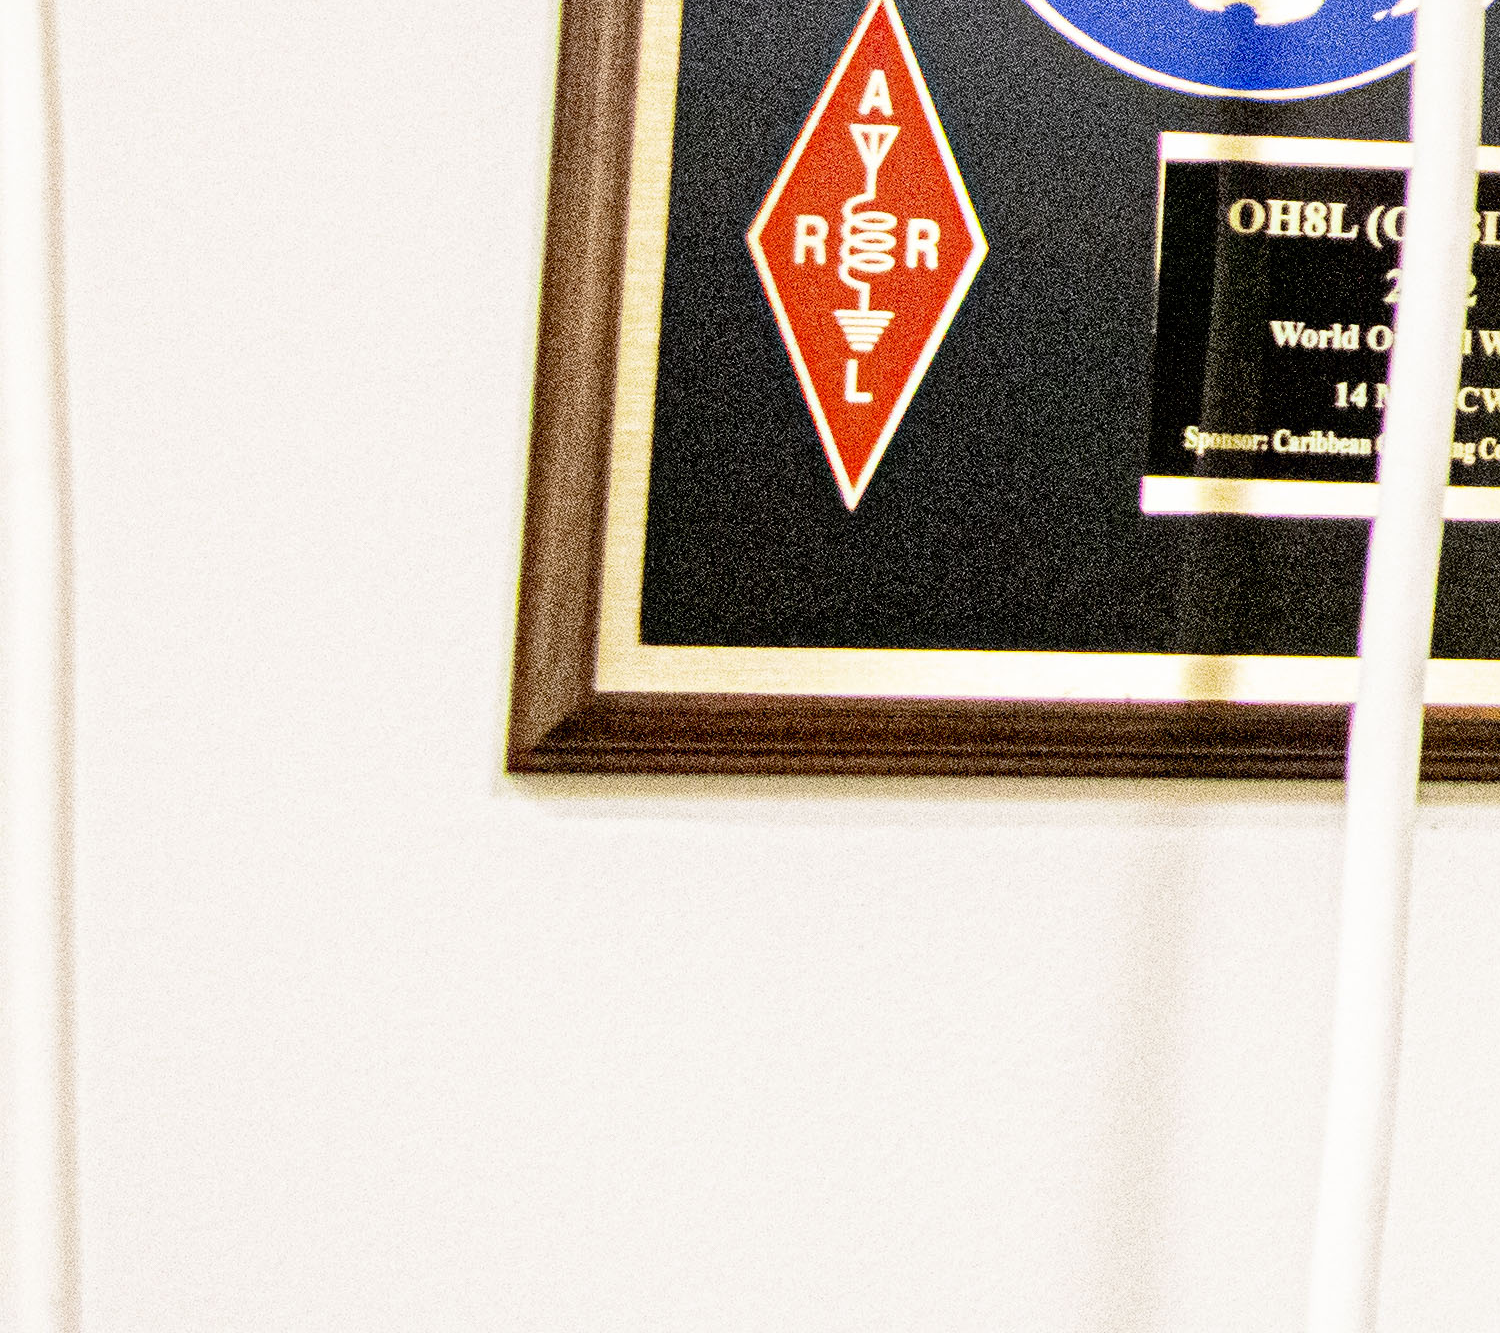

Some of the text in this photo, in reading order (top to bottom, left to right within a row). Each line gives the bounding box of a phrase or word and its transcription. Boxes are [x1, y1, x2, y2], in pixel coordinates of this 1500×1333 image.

[1228, 199, 1358, 241] OH8L
[1383, 268, 1478, 308] 22
[1270, 320, 1360, 352] World
[1334, 381, 1367, 410] 14
[1183, 426, 1268, 456] Sponsor:
[1272, 429, 1371, 456] Caribbean
